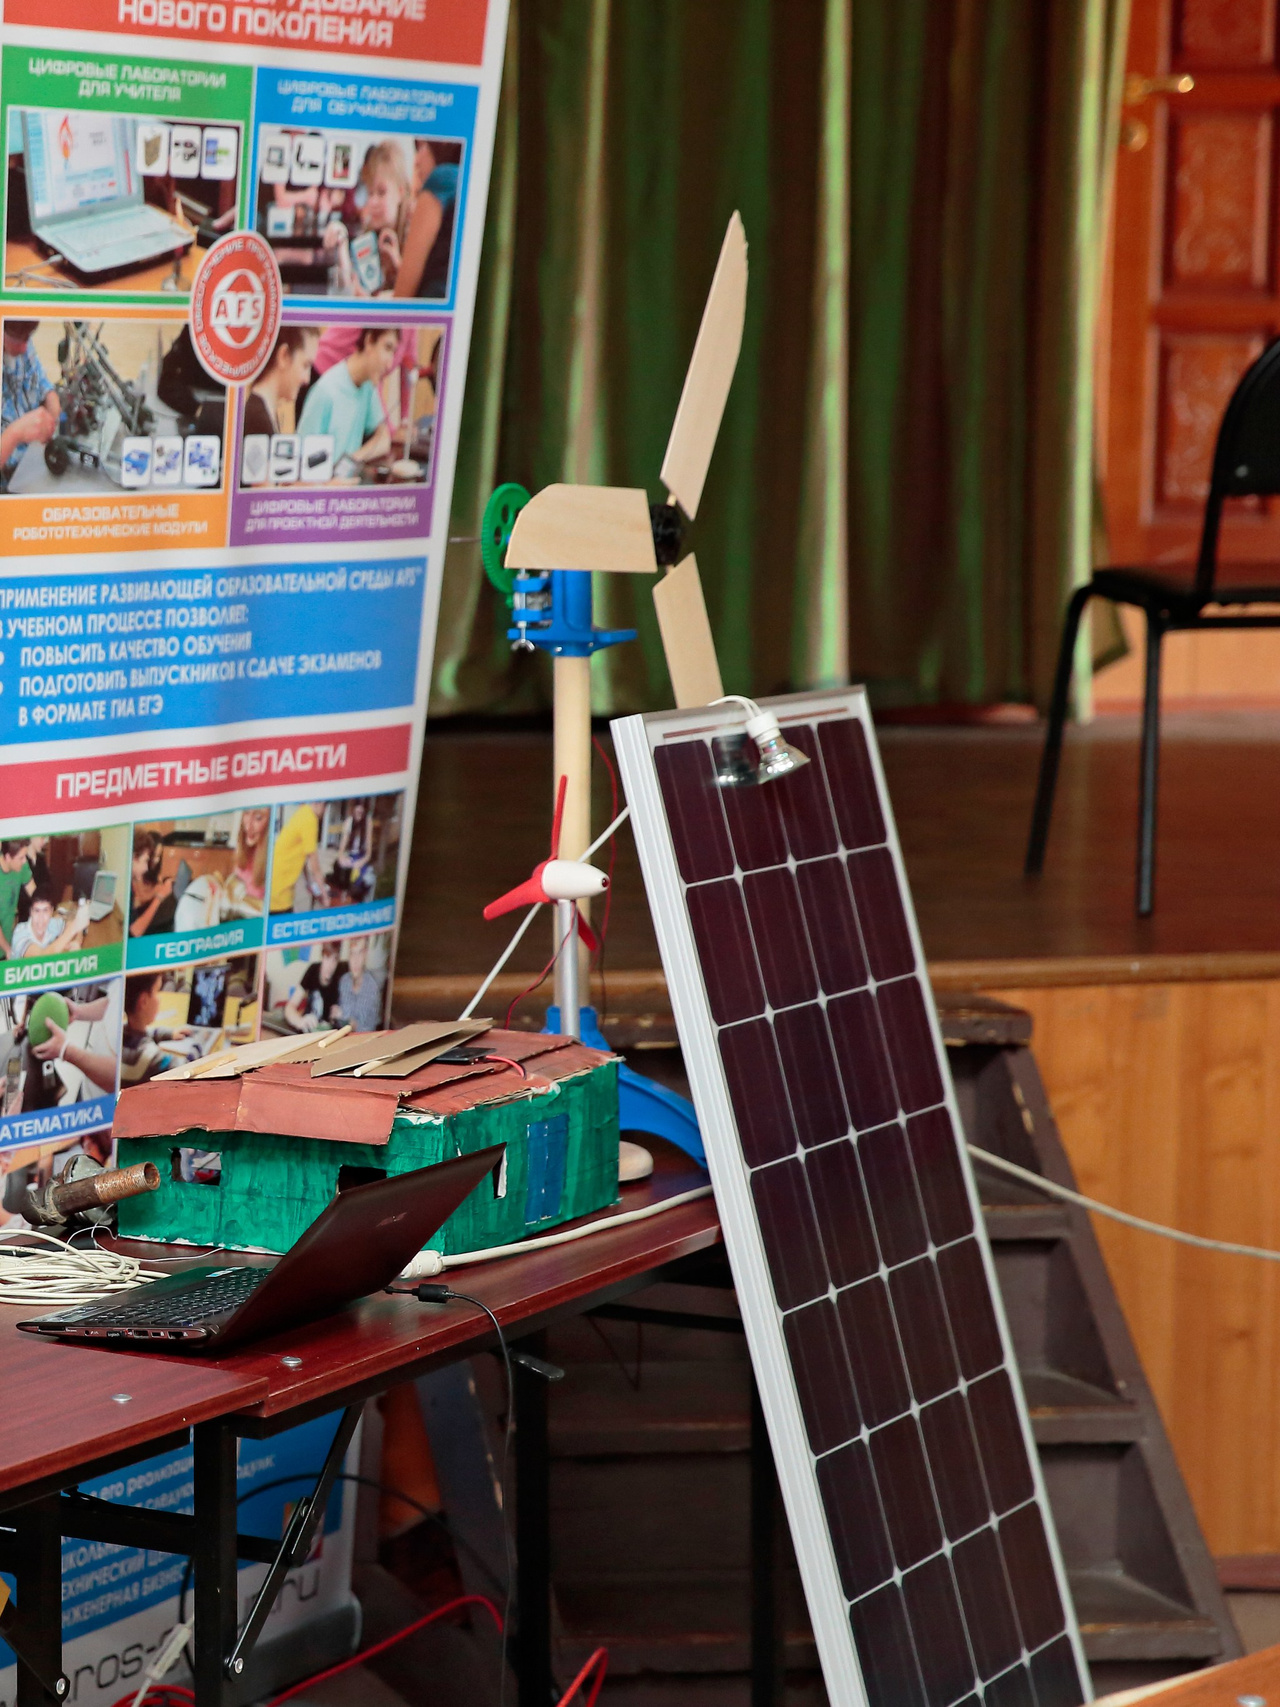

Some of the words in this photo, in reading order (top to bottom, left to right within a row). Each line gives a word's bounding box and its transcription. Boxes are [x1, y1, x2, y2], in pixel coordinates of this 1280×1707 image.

[117, 0, 226, 31] НОВОГО
[232, 6, 394, 47] ПОКОЛЕНИЯ
[28, 57, 119, 80] ЦИФРОВЫЕ
[121, 64, 227, 89] ЛАБОРАТОРИИ
[78, 80, 111, 98] ДЛЯ
[113, 82, 182, 102] УЧИТЕЛЯ
[291, 96, 322, 114] ДЛЯ
[215, 299, 261, 320] AFS
[42, 503, 180, 523] ОБРАЗОВАТЕЛЬНЫЕ
[250, 498, 326, 516] ЦИФРОВЫЕ
[13, 522, 150, 541] РОБОТОТЕХНИЧЕСКИЕ
[153, 520, 208, 536] МОДУЛИ
[100, 573, 213, 604] РАЗВИВАЮЩЕЙ
[215, 566, 347, 598] ОБРАЗОВАТЕЛЬНОЙ
[348, 568, 394, 591] СРЕДЫ
[7, 615, 83, 639] УЧЕБНОМ
[87, 609, 162, 634] ПРОЦЕССЕ
[20, 643, 106, 667] ПОВЫСИТЬ
[109, 636, 180, 661] КАЧЕСТВО
[183, 631, 252, 656] ОБУЧЕНИЯ
[19, 669, 128, 698] ПОДГОТОВИТЬ
[130, 659, 235, 689] ВЫПУСКНИКОВ
[238, 659, 246, 678] К
[247, 655, 296, 679] СДАЧЕ
[297, 649, 383, 676] ЭКЗАМЕНОВ
[18, 706, 28, 727] В
[31, 699, 106, 725] ФОРМАТЕ
[110, 697, 135, 719] ГИА
[138, 694, 164, 716] ЕГЭ
[56, 756, 228, 799] ПРЕДМЕТНЫЕ
[231, 743, 348, 779] ОБЛАСТИ
[272, 903, 394, 940] ЕСТЕСТВОЗНАНИЕ
[154, 928, 244, 960] ГЕОГРАФИЯ
[4, 953, 98, 985] БИОЛОГИЯ
